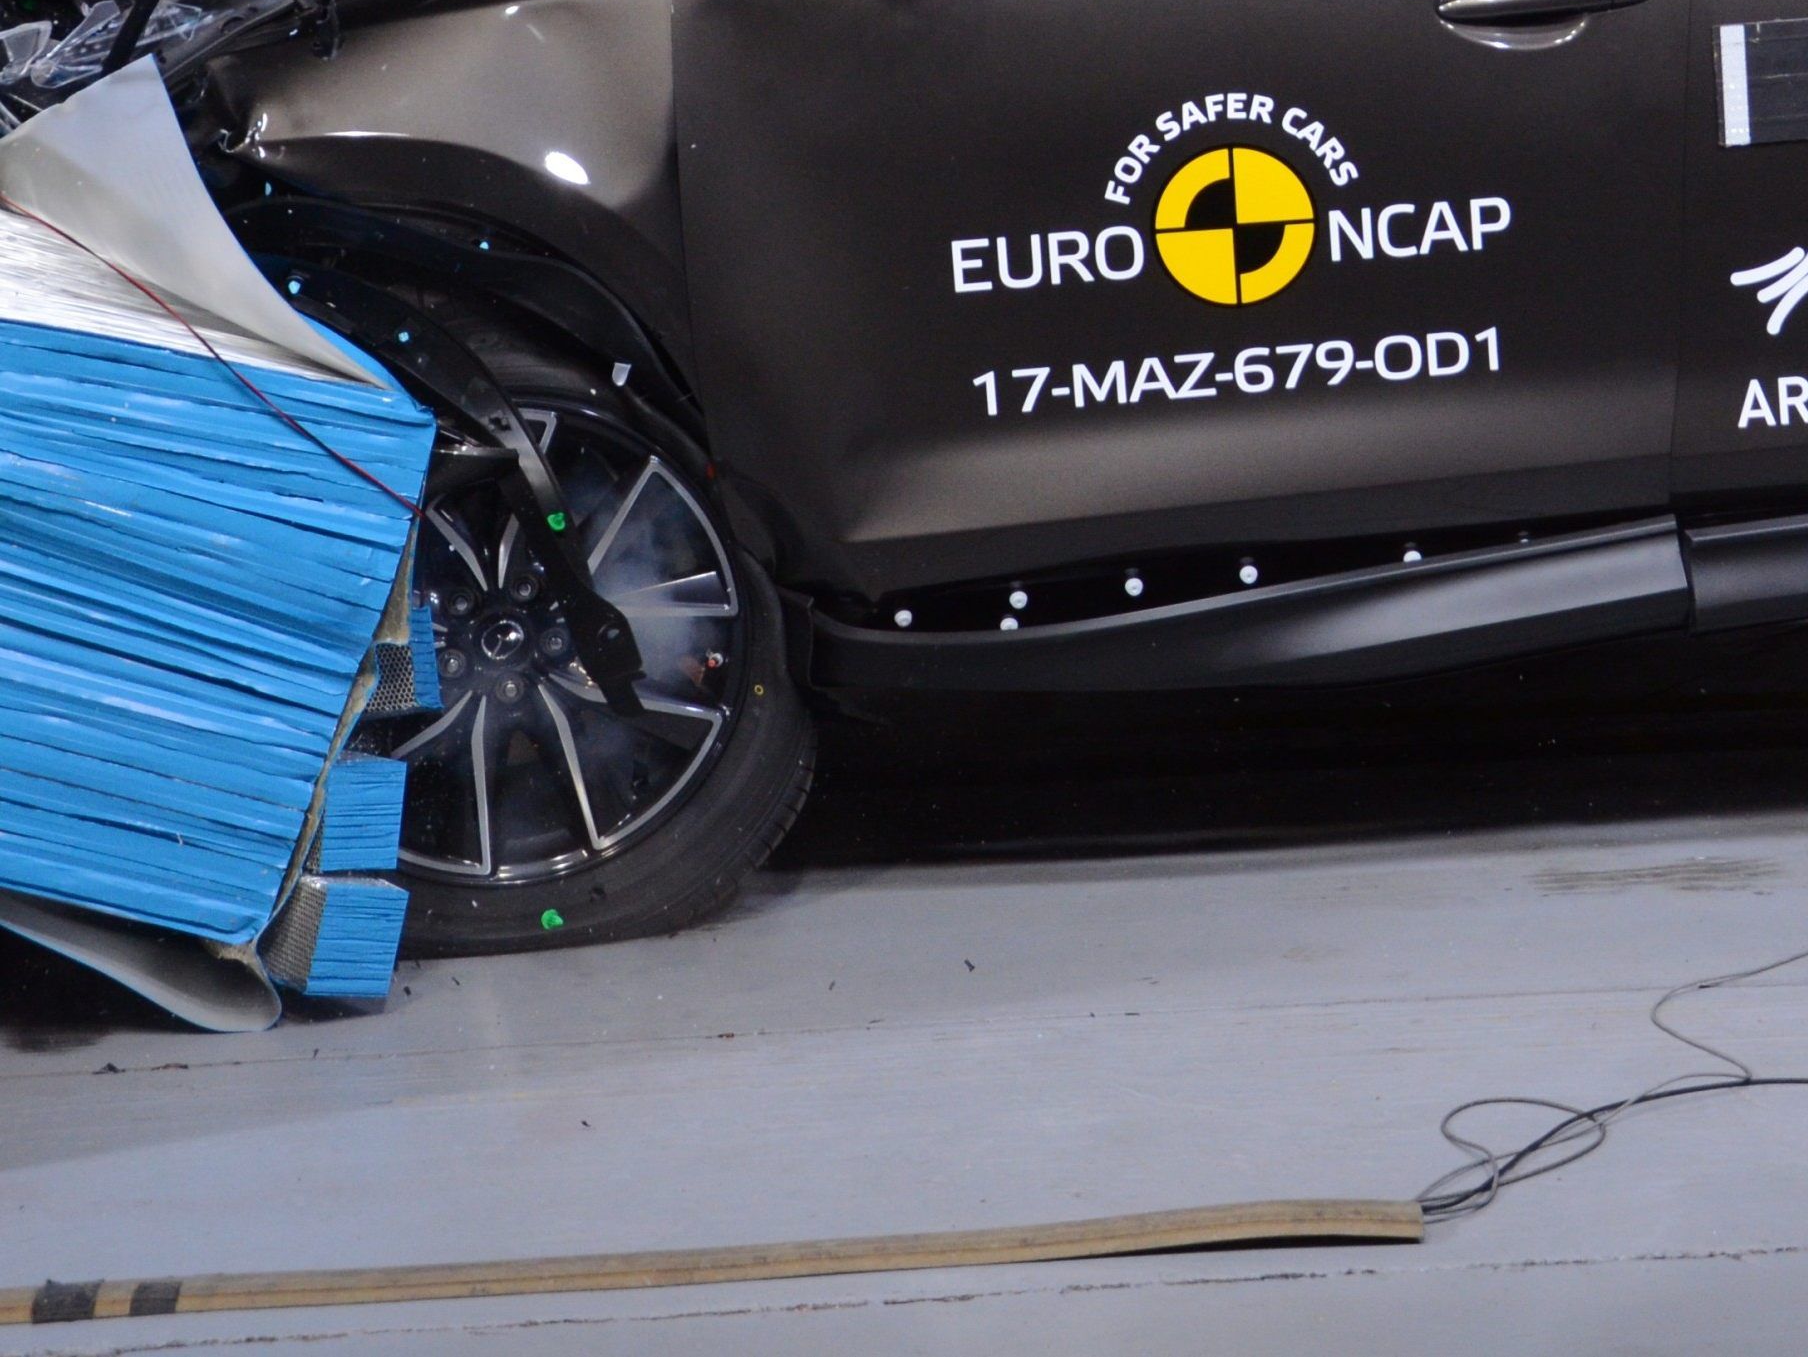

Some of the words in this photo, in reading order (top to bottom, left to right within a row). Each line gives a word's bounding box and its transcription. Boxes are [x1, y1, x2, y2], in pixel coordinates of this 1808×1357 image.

[1104, 134, 1161, 205] FOR
[1155, 92, 1275, 142] SAFER
[1281, 107, 1359, 187] CARS
[951, 225, 1145, 293] EURO
[1328, 196, 1511, 262] NCAP
[972, 326, 1500, 416] 17-MAZ-679-OD1
